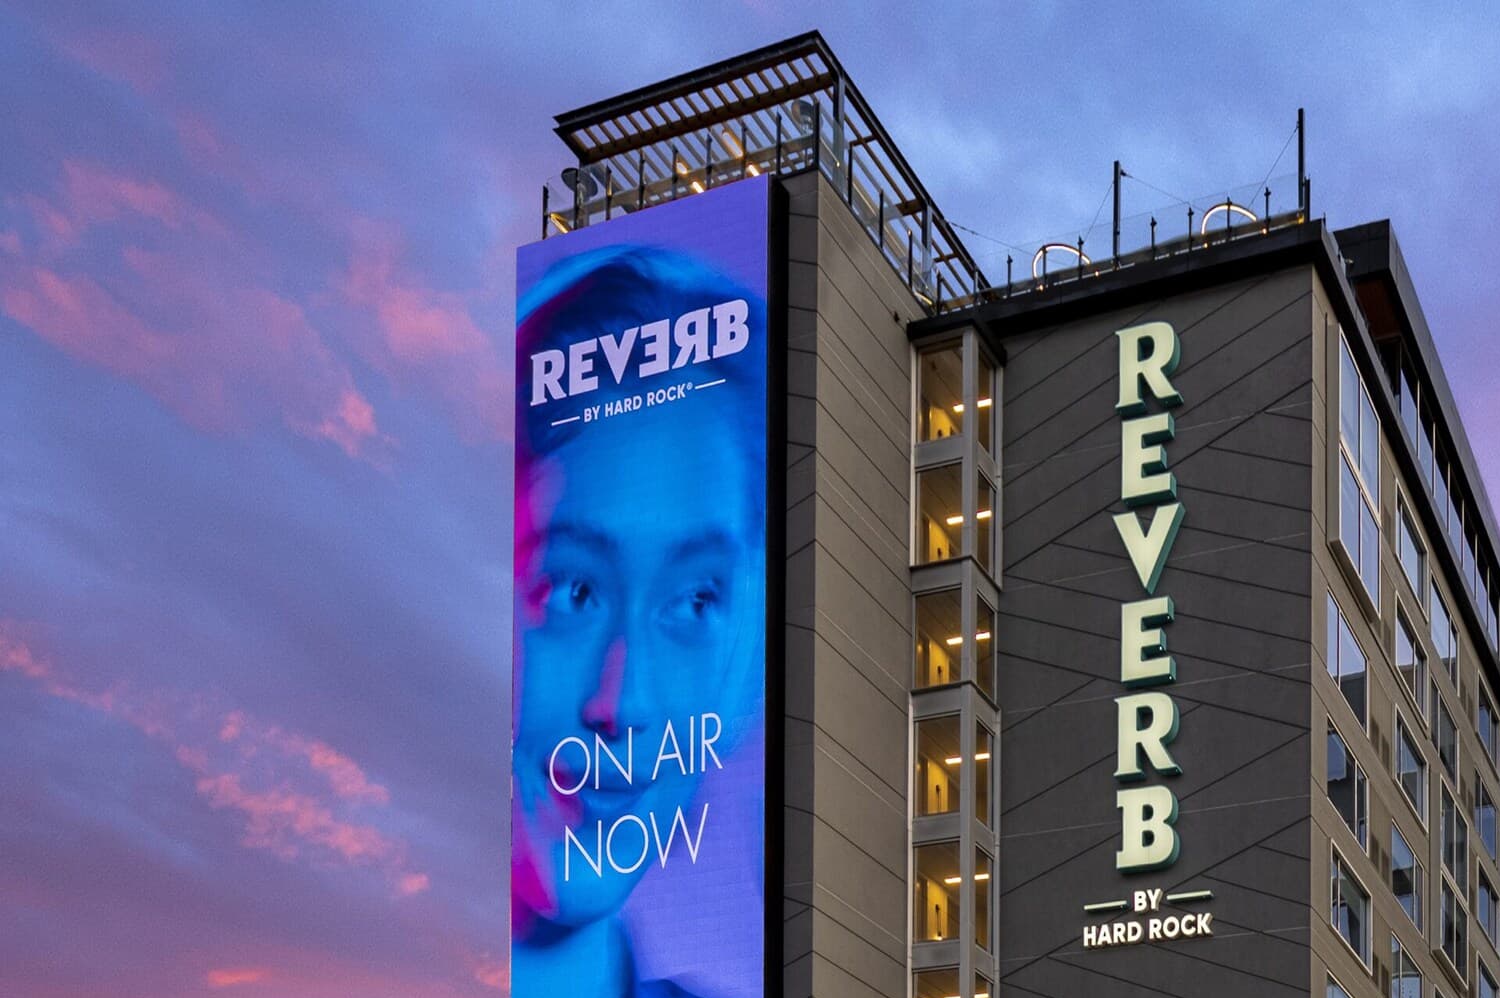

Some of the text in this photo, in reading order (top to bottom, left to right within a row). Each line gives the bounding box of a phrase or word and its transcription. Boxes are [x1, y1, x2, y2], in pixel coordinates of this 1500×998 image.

[530, 299, 749, 406] REVERB
[584, 405, 601, 423] BY
[604, 395, 643, 417] HARD
[1112, 321, 1184, 874] REVERB
[549, 712, 723, 795] ON AIR
[564, 802, 709, 882] NOW
[1083, 912, 1213, 947] HARD ROCK
[1134, 888, 1162, 912] BY
